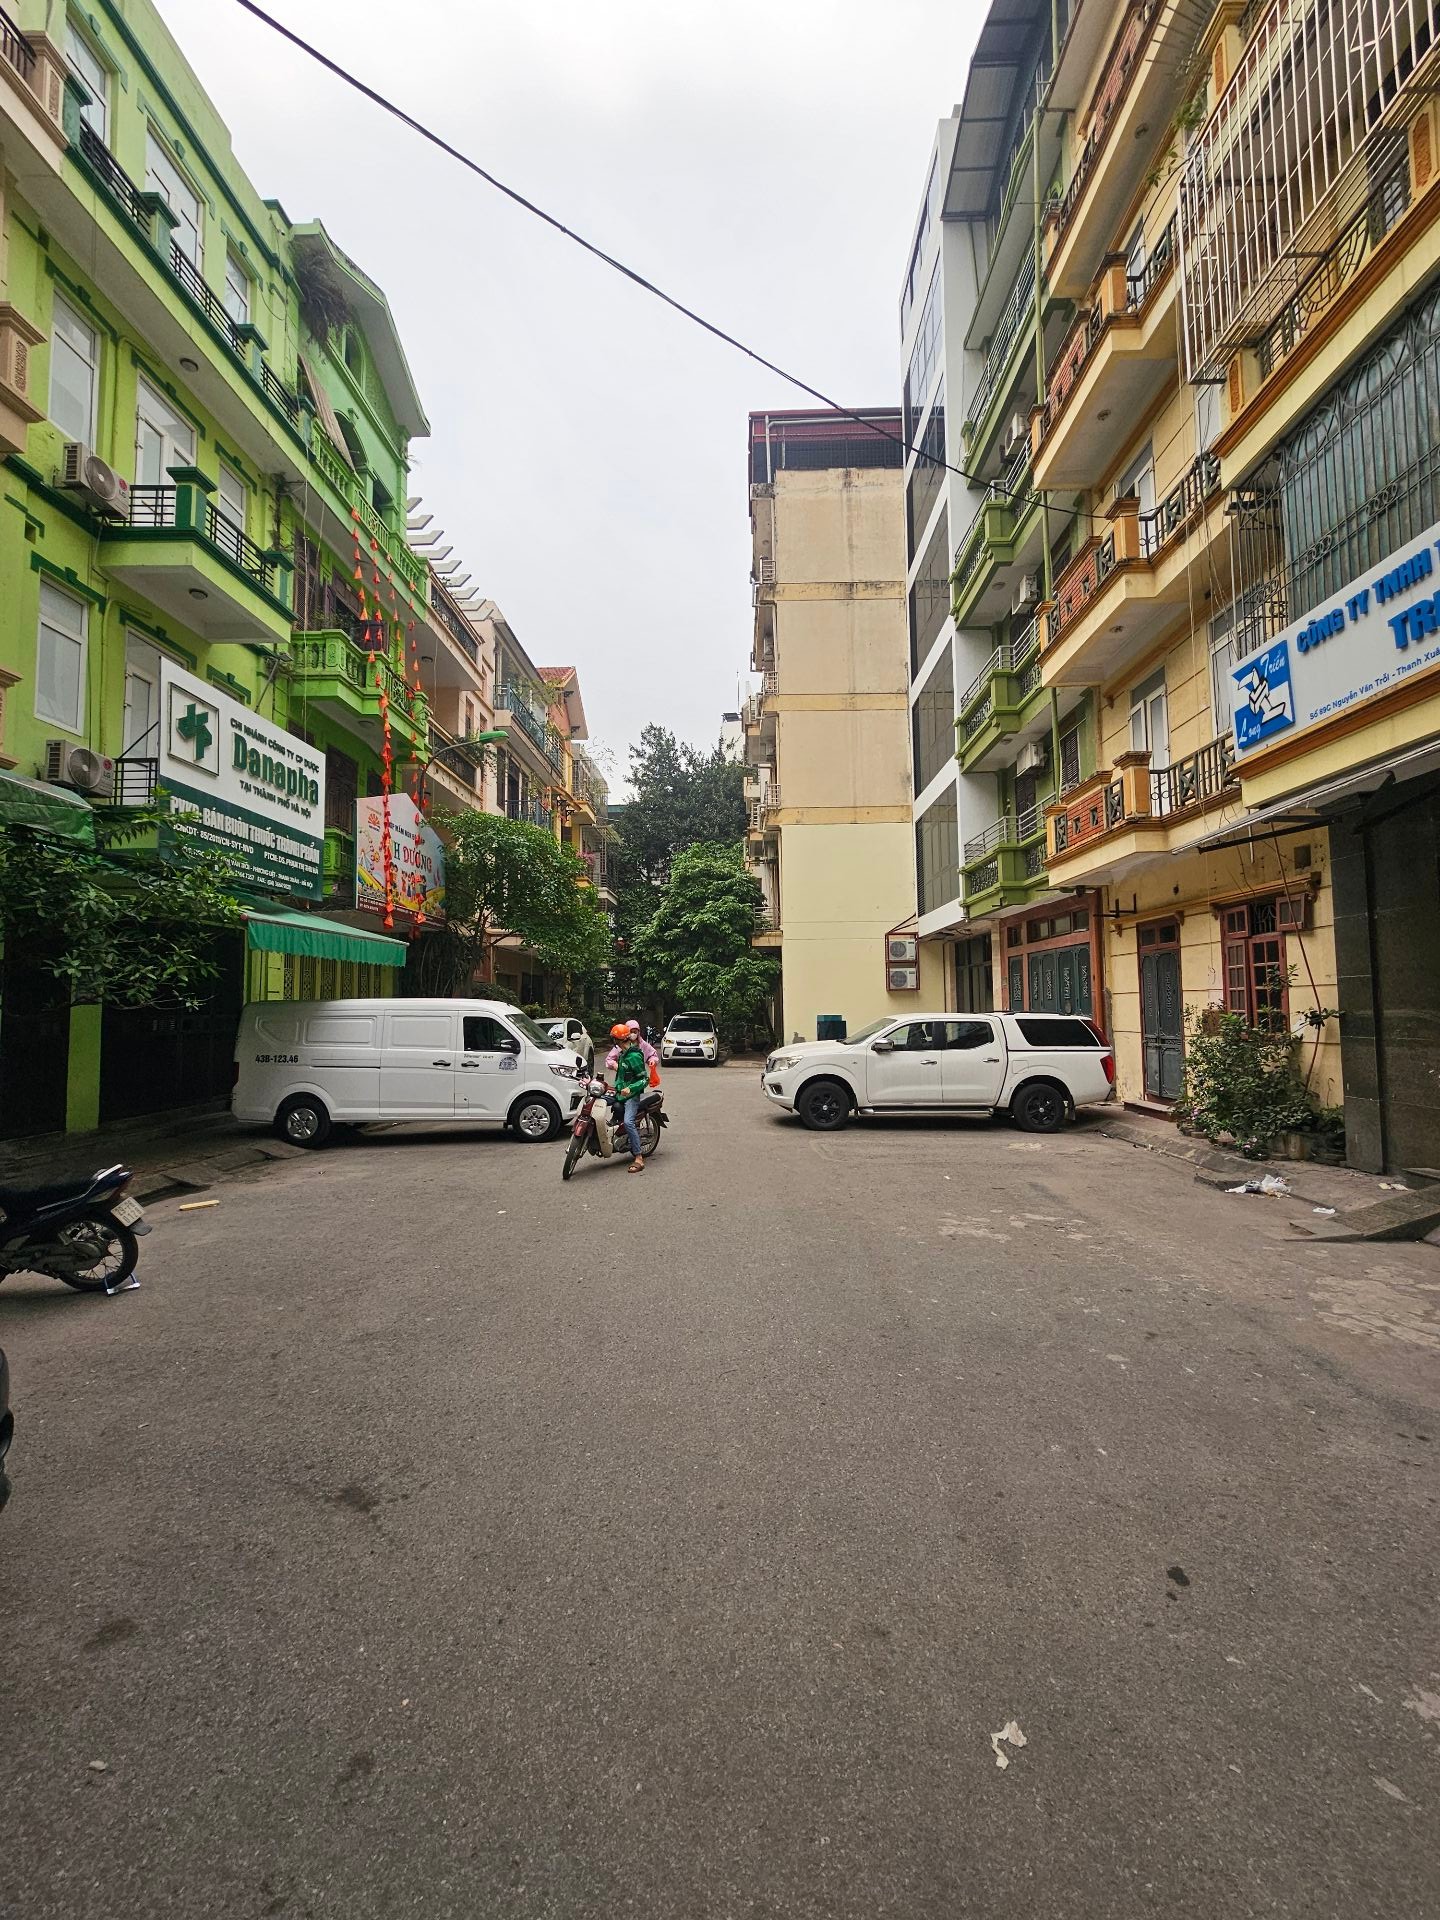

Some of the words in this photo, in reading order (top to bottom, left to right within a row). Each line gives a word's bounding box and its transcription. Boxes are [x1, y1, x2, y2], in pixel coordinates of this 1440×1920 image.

[1296, 608, 1345, 652] CÔNG
[1345, 589, 1369, 621] TY
[1372, 548, 1432, 603] TNHH
[1396, 656, 1422, 676] Thanh
[230, 717, 243, 731] CHI
[244, 724, 267, 746] NHÁNH
[268, 739, 286, 756] CÔNG
[286, 748, 295, 760] TY
[232, 732, 319, 807] Danapha
[240, 779, 252, 793] TẠI
[203, 807, 225, 832] BÁN
